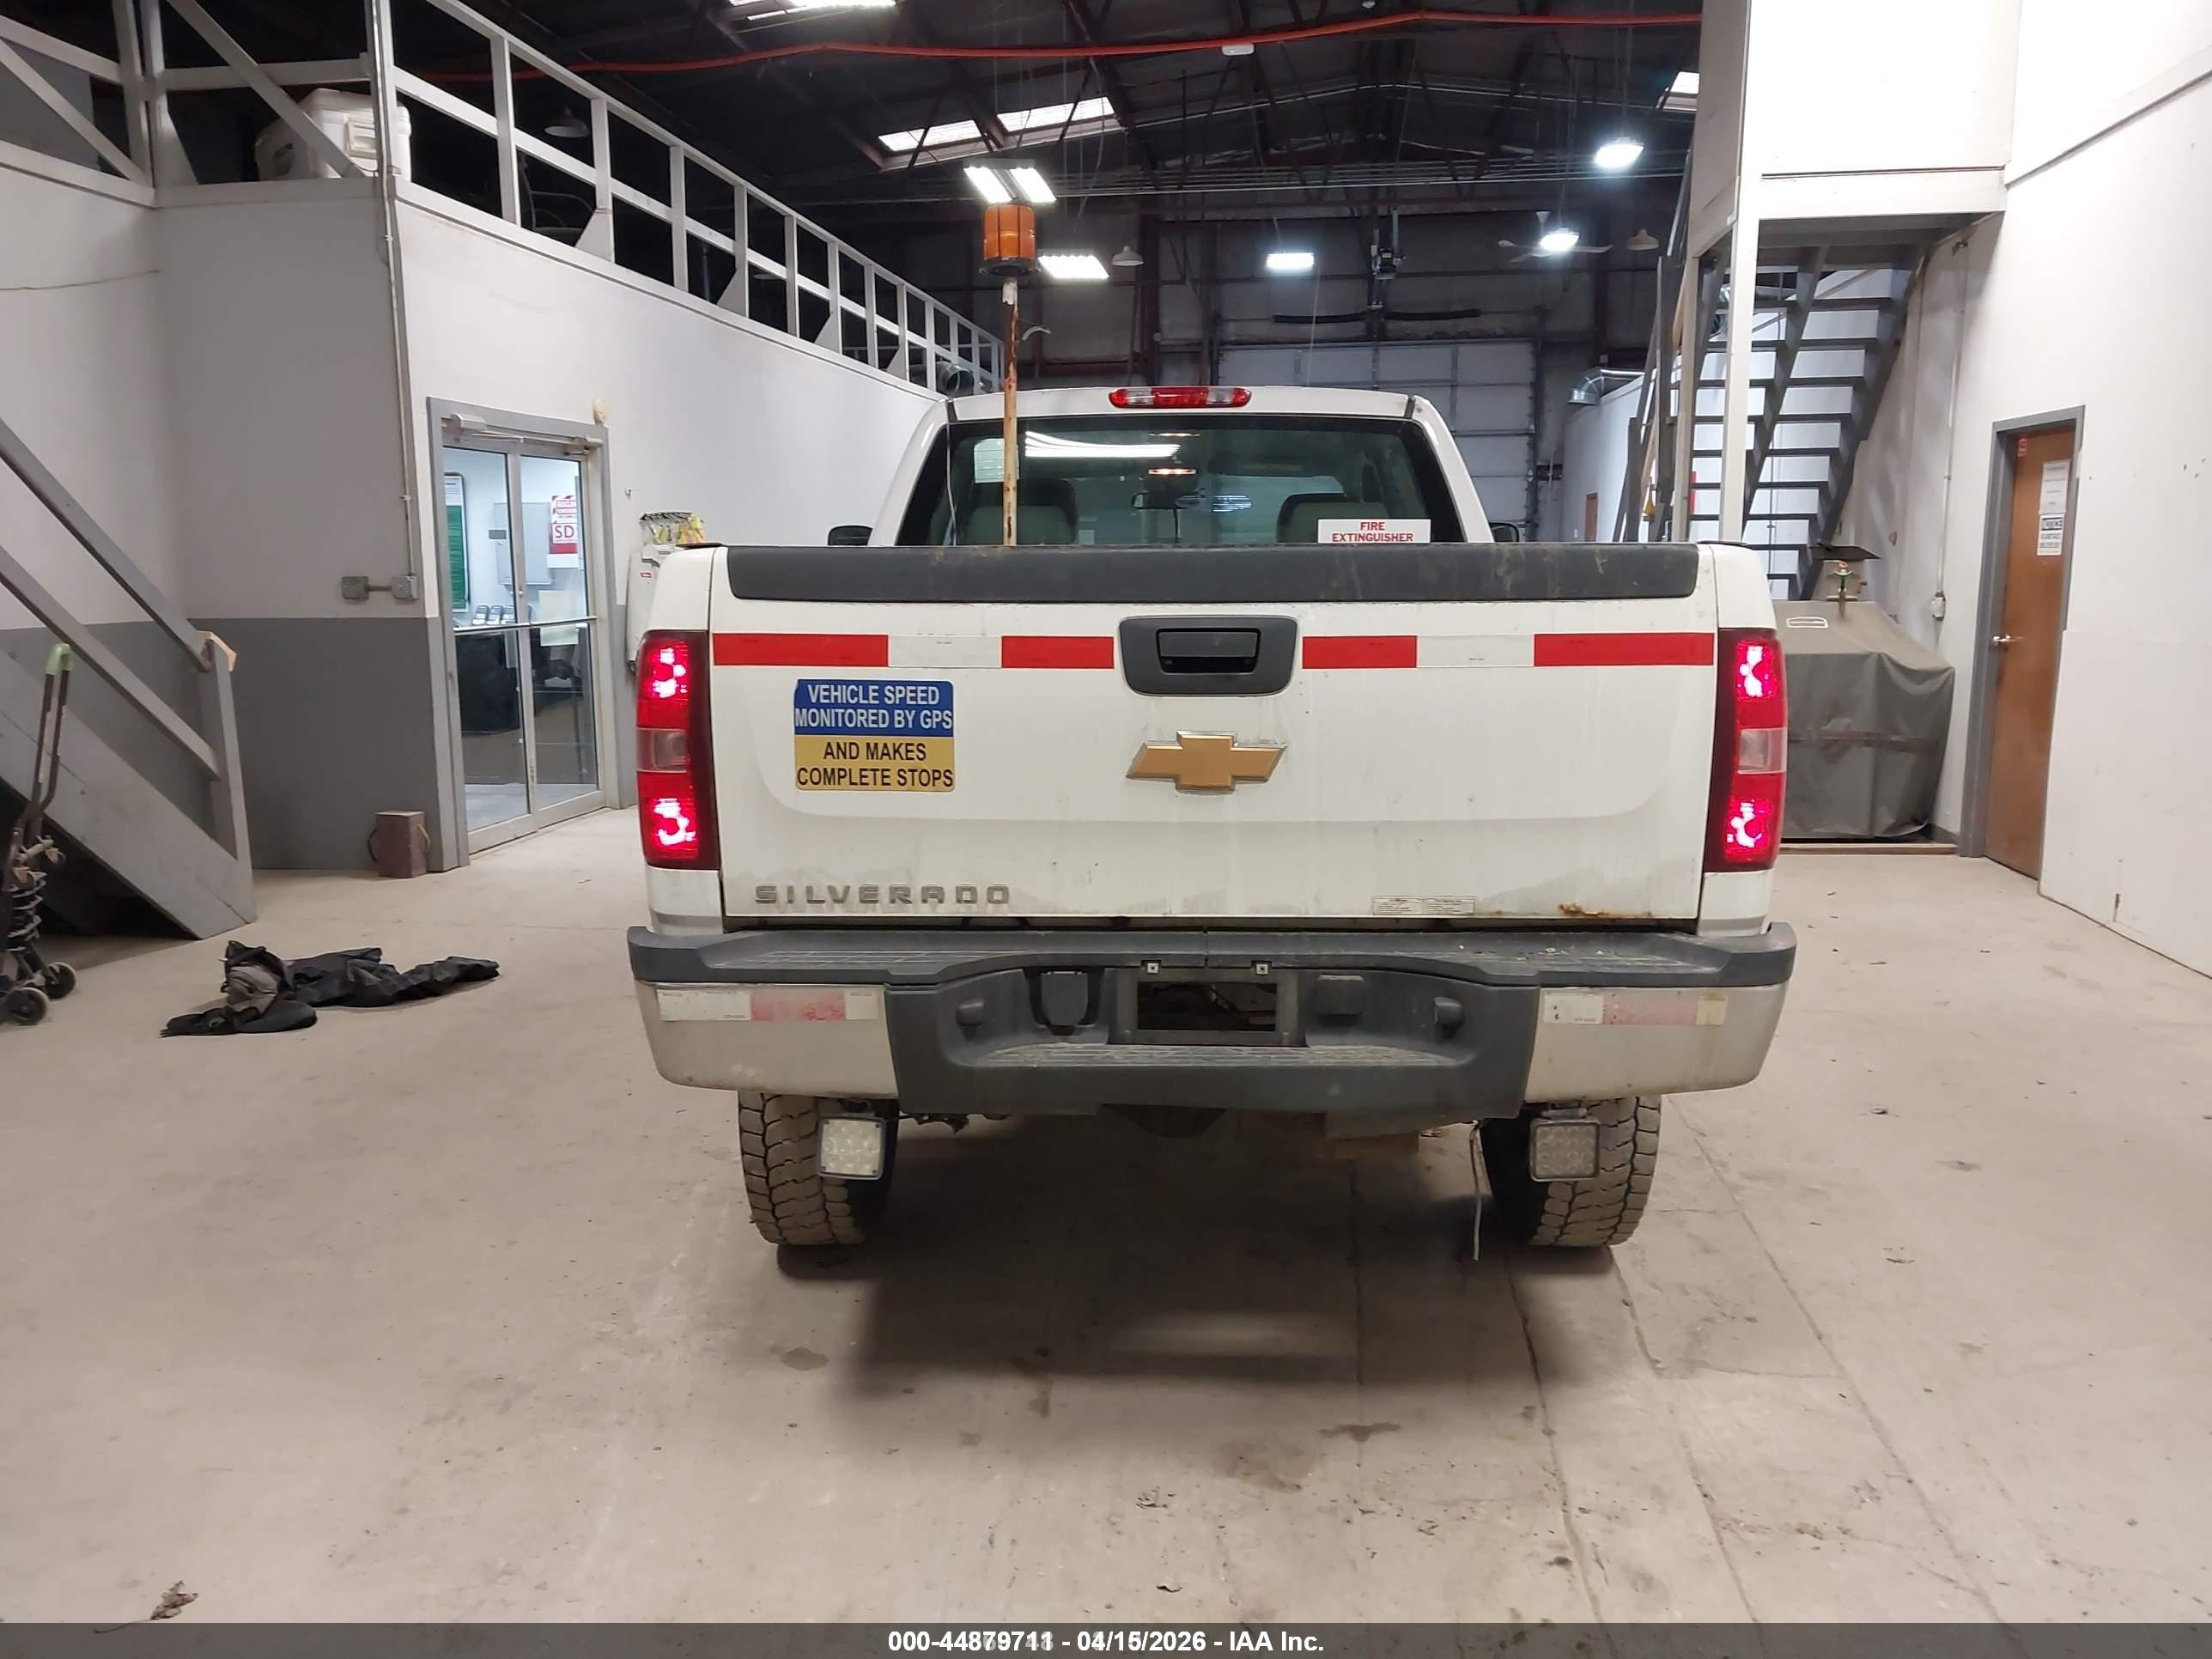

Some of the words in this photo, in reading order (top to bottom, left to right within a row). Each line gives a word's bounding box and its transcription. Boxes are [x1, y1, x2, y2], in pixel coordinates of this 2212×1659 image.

[1359, 521, 1385, 531] FIRE
[1332, 532, 1413, 542] EXTINGUISHER
[808, 684, 879, 704] VEHICLE
[884, 685, 940, 705] SPEED
[794, 708, 889, 728] MONITORED
[894, 709, 916, 728] BY
[920, 709, 953, 729] GPS
[823, 742, 860, 760] AND
[866, 742, 927, 761] MAKES
[797, 768, 891, 786] COMPLETE
[896, 769, 953, 787] STOPS
[755, 884, 1010, 904] SILVERADO
